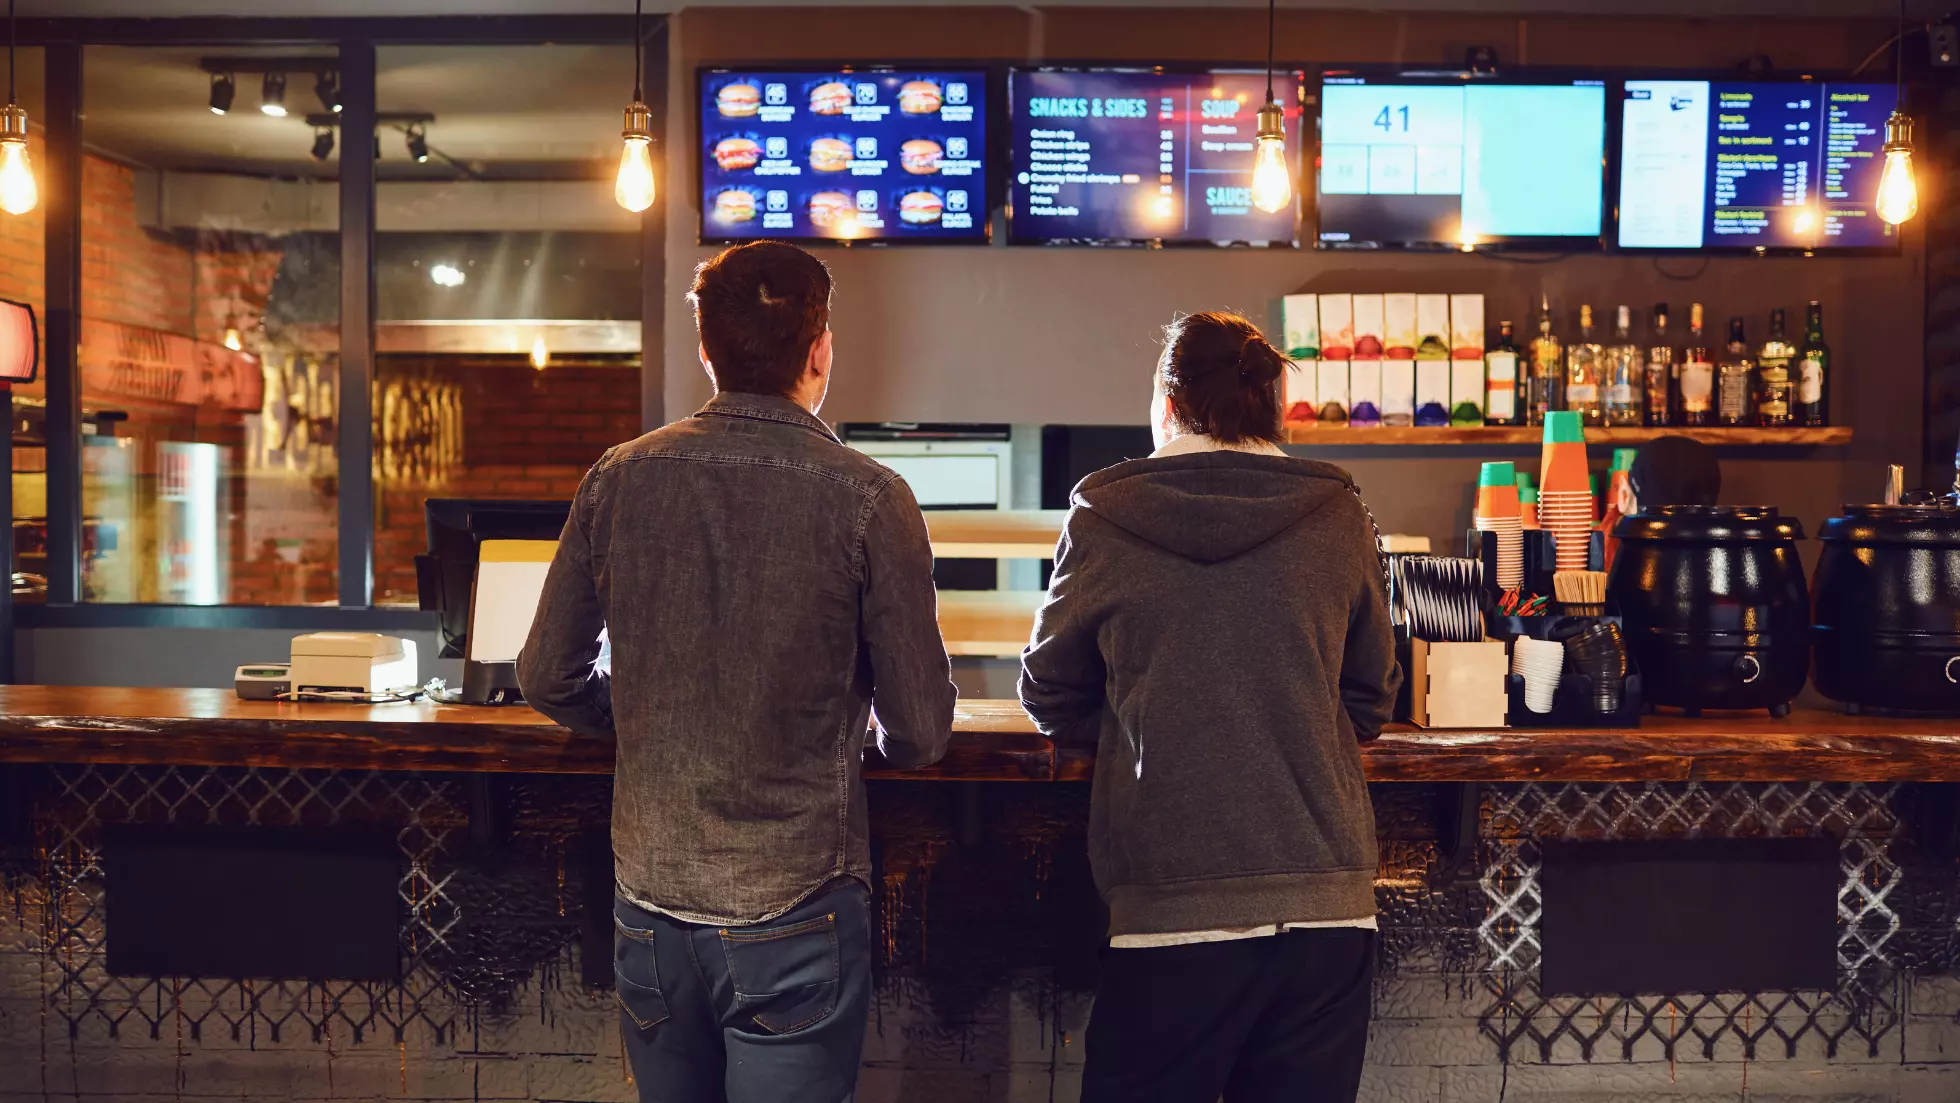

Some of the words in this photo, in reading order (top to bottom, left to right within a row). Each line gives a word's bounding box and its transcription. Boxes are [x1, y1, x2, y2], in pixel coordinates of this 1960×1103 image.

[1029, 98, 1088, 118] SNACKS
[1091, 98, 1104, 118] &
[1105, 98, 1147, 118] SIDES
[1202, 99, 1240, 118] SOUP
[1374, 105, 1410, 132] 41
